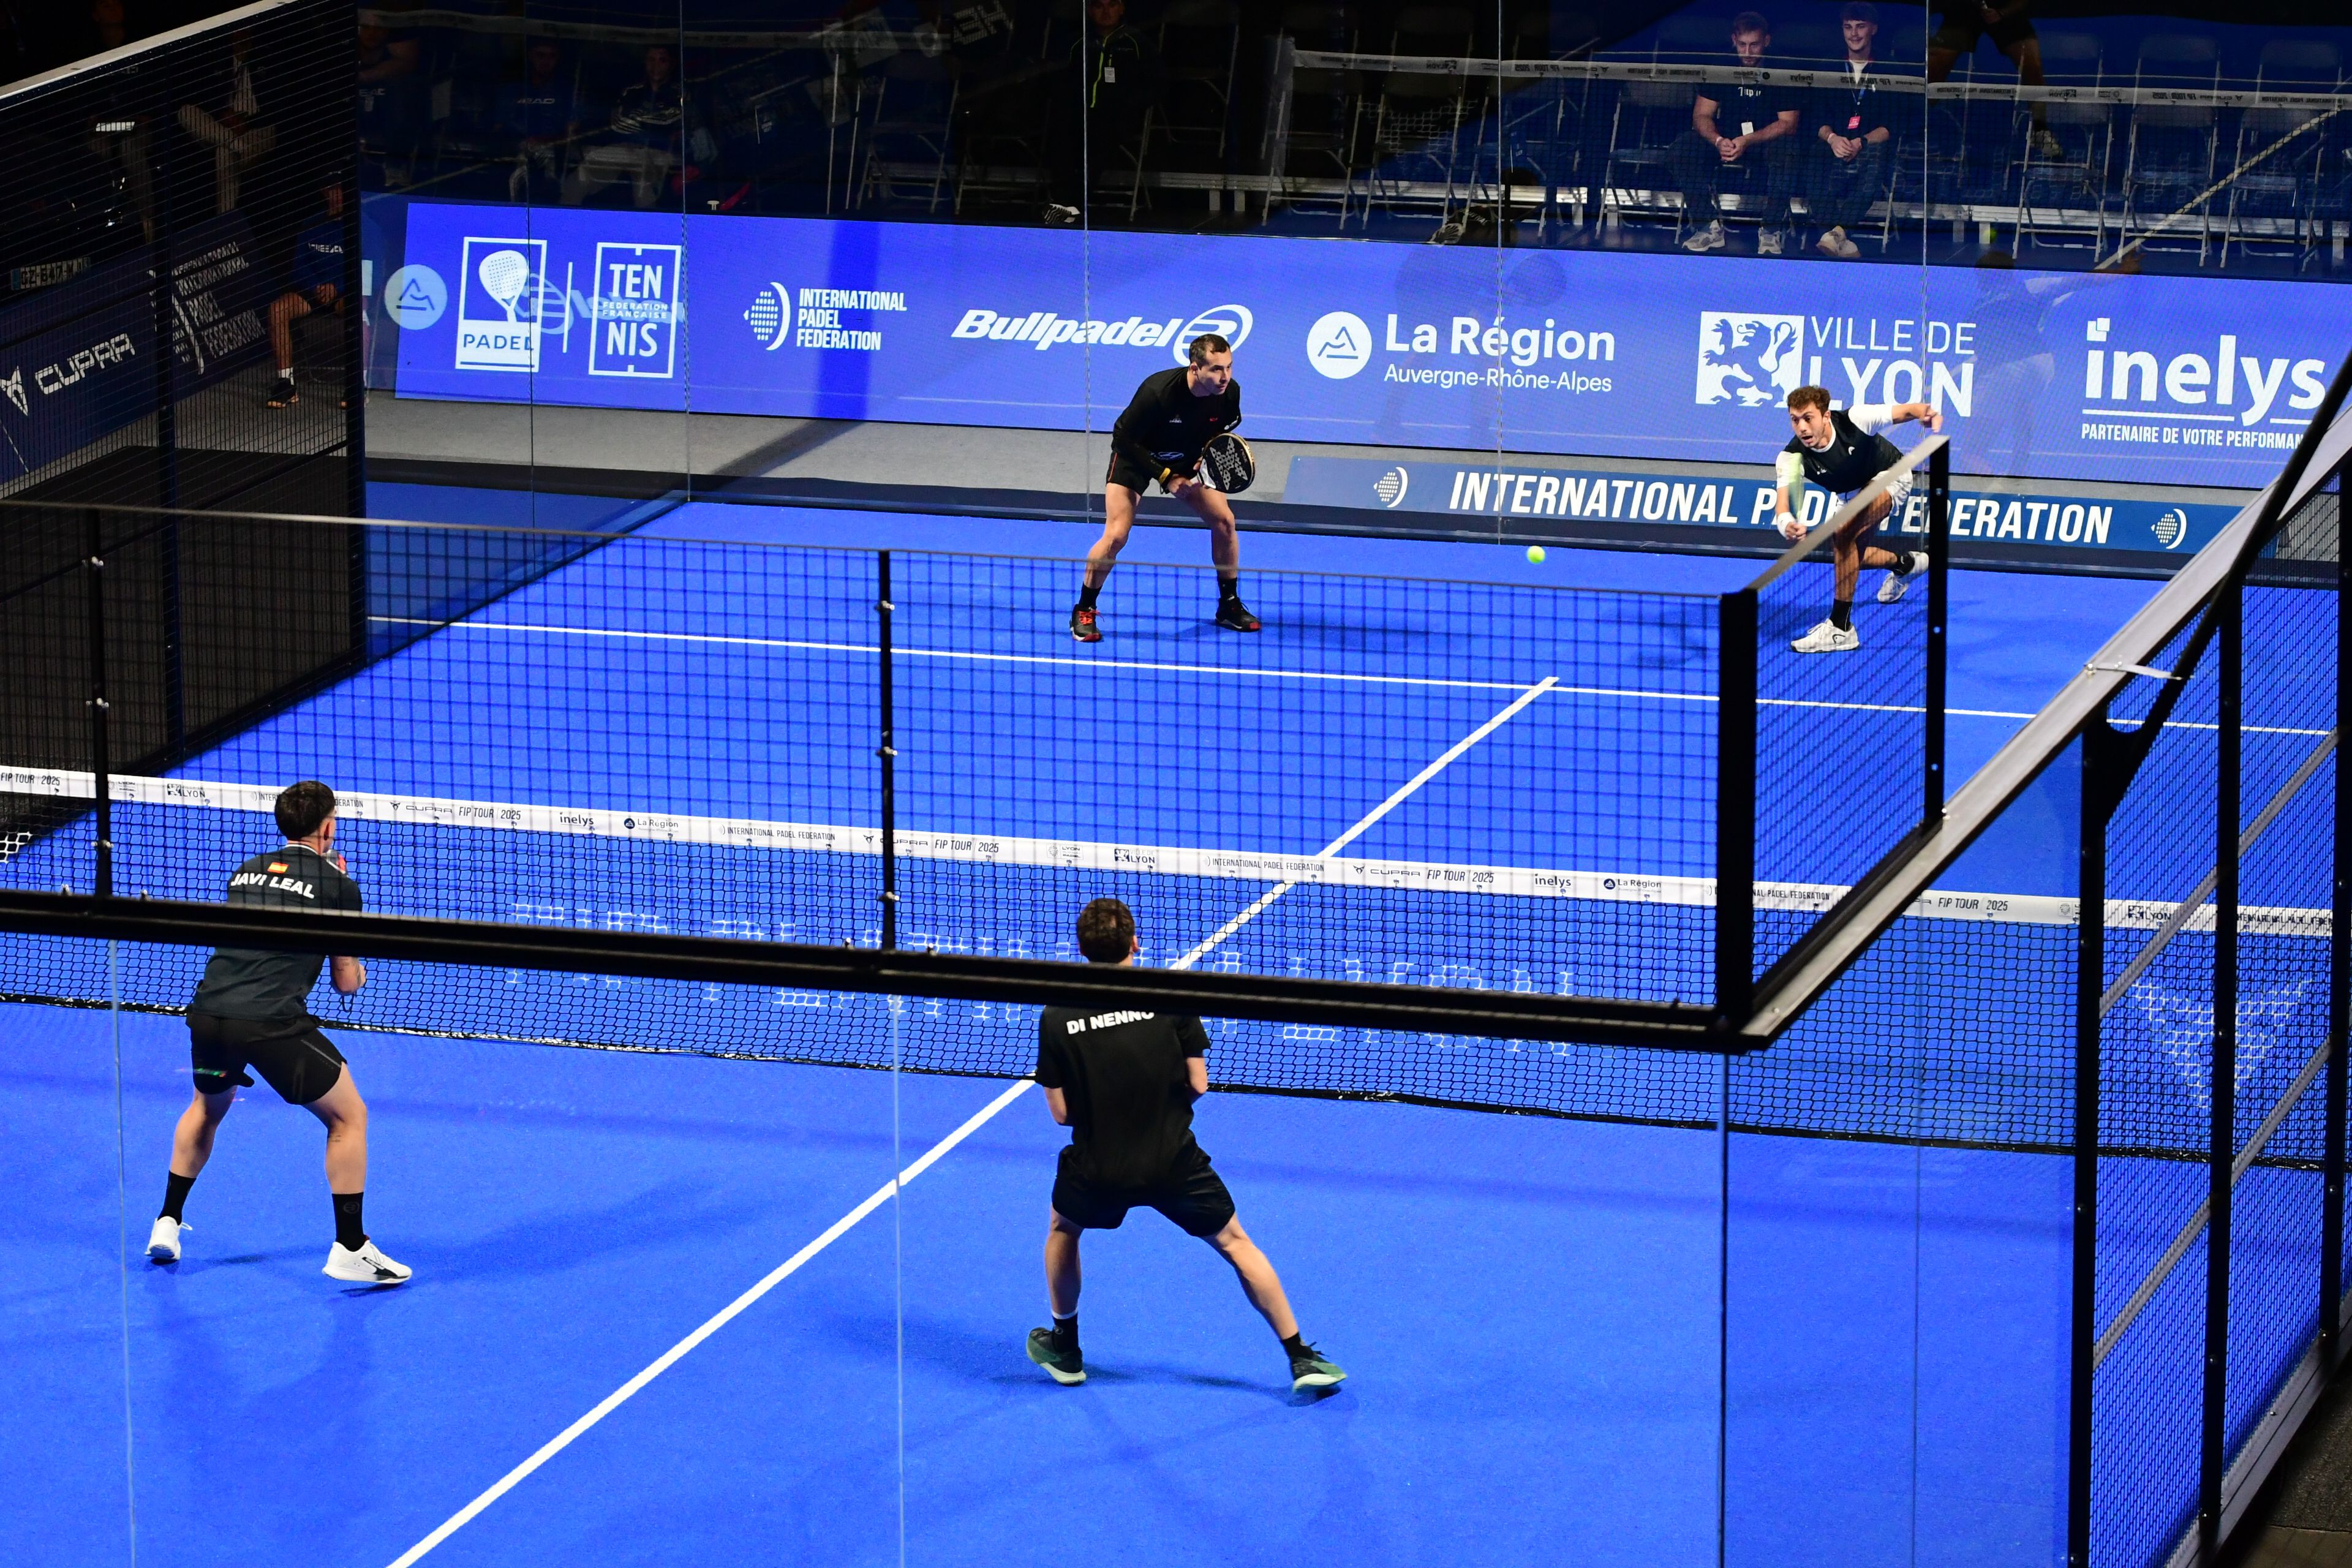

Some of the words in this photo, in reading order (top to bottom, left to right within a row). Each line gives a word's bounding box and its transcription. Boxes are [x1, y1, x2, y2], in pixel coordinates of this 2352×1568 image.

[610, 263, 662, 299] TEN
[799, 288, 907, 311] INTERNATIONAL
[798, 308, 842, 329] PADEL
[951, 309, 1183, 350] Bullpadel
[1811, 316, 1914, 352] VILLE
[1928, 321, 1977, 355] DE
[463, 333, 534, 352] PADEL
[608, 322, 658, 358] NIS
[797, 328, 881, 351] FEDERATION
[1385, 314, 1437, 353] La
[1451, 316, 1615, 367] Région
[1384, 363, 1612, 394] Auvergne-Rhône-Alpes
[2085, 318, 2326, 427] inelys
[1808, 355, 1975, 417] LYON
[2082, 423, 2159, 443] PARTENAIRE
[2163, 428, 2179, 444] DE
[2182, 429, 2223, 447] VOTRE
[2226, 431, 2304, 450] PERFORMAN
[1450, 472, 1738, 524] INTERNATIONAL
[1878, 494, 2113, 544] EERATION
[1, 772, 13, 782] FIP
[15, 774, 35, 784] TOUR
[41, 775, 61, 786] 2025
[183, 789, 206, 799] LYON
[334, 799, 363, 809] DERATION
[406, 805, 453, 813] CUPRA
[459, 806, 471, 817] FIP
[473, 807, 494, 819] TOUR
[500, 809, 521, 821] 2025
[559, 812, 594, 826] inelys
[637, 818, 647, 827] La
[727, 826, 774, 837] INTERNATIONAL
[776, 829, 796, 839] PADEL
[798, 831, 835, 841] FEDERATION
[935, 839, 949, 850] FIP
[951, 840, 972, 851] TOUR
[978, 842, 999, 853] 2025
[1131, 855, 1156, 864] LYON
[1213, 858, 1261, 869] INTERNATIONAL
[1264, 861, 1283, 870] PADEL
[1287, 862, 1324, 872] FEDERATION
[1427, 870, 1441, 881] FIP
[1444, 870, 1465, 882] TOUR
[1472, 872, 1494, 884] 2025
[1535, 873, 1572, 888] inelys
[230, 873, 267, 887] JAVI
[269, 876, 315, 899] LEAL
[1767, 889, 1787, 899] PADEL
[1790, 890, 1830, 900] FEDERATION
[1938, 897, 1953, 908] FIP
[1954, 898, 1978, 910] TOUR
[1986, 900, 2008, 911] 2025
[1066, 1019, 1086, 1035] DI
